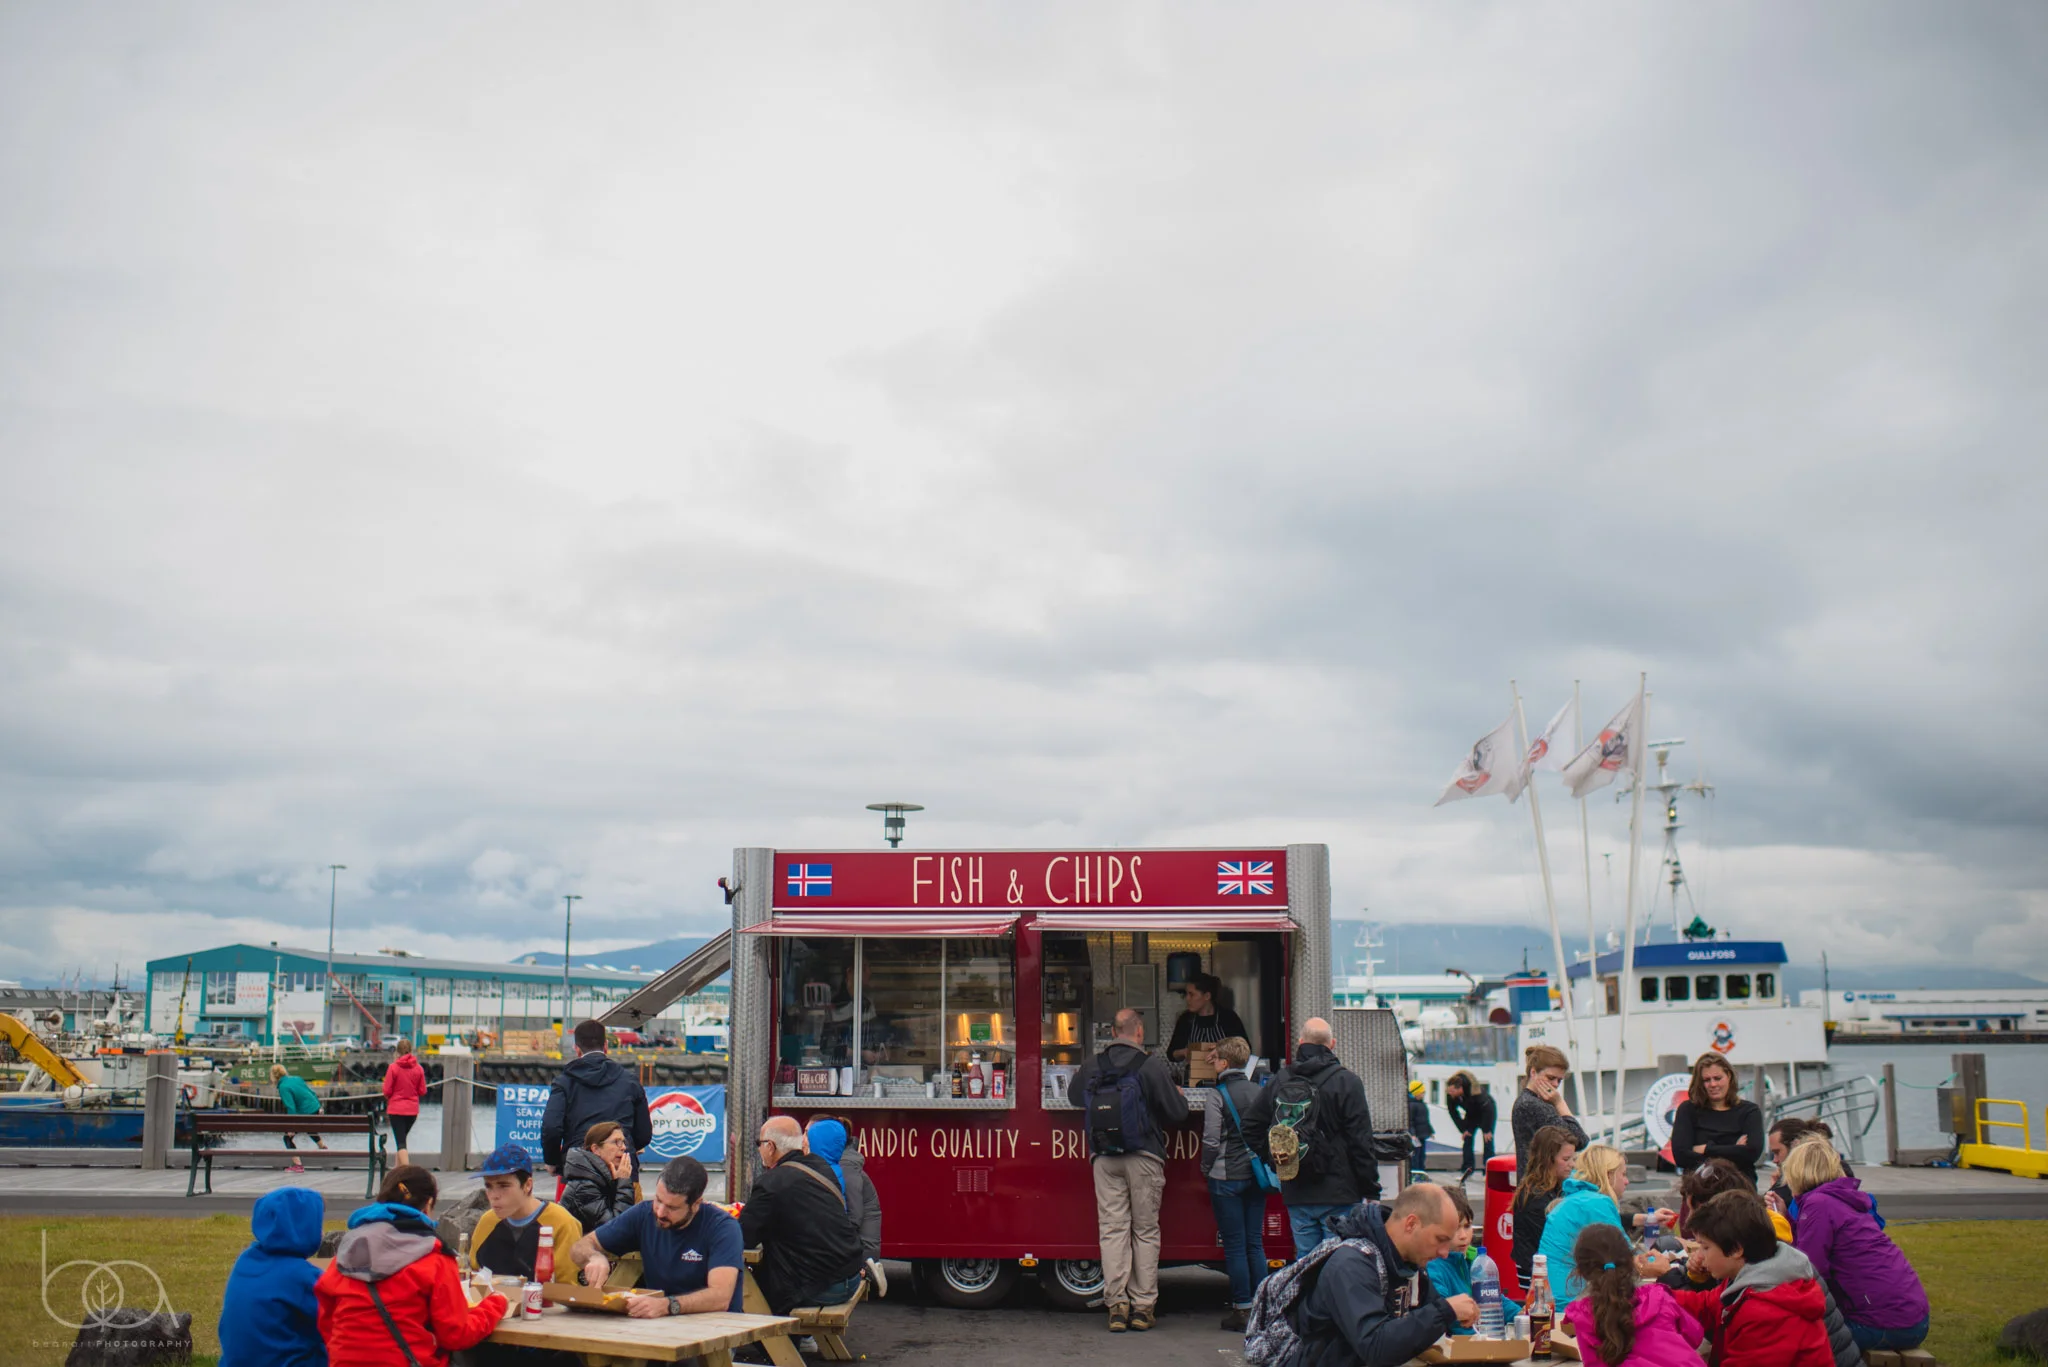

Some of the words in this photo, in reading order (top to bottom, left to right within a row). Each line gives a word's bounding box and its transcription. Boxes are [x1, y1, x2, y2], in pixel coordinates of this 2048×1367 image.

[913, 856, 983, 904] FISH
[1006, 868, 1024, 904] &
[1045, 855, 1142, 904] CHIPS
[1687, 949, 1737, 961] GULLFOSS
[503, 1087, 550, 1102] DEPA
[516, 1107, 532, 1117] SEA
[516, 1119, 543, 1129] PUFFI
[652, 1119, 672, 1128] PPY
[676, 1118, 712, 1128] TOURS
[509, 1130, 542, 1140] GLACIA
[858, 1127, 918, 1158] ANDIC
[930, 1128, 1019, 1158] QUALITY
[1051, 1129, 1086, 1159] BRI
[1480, 1288, 1499, 1297] PURE
